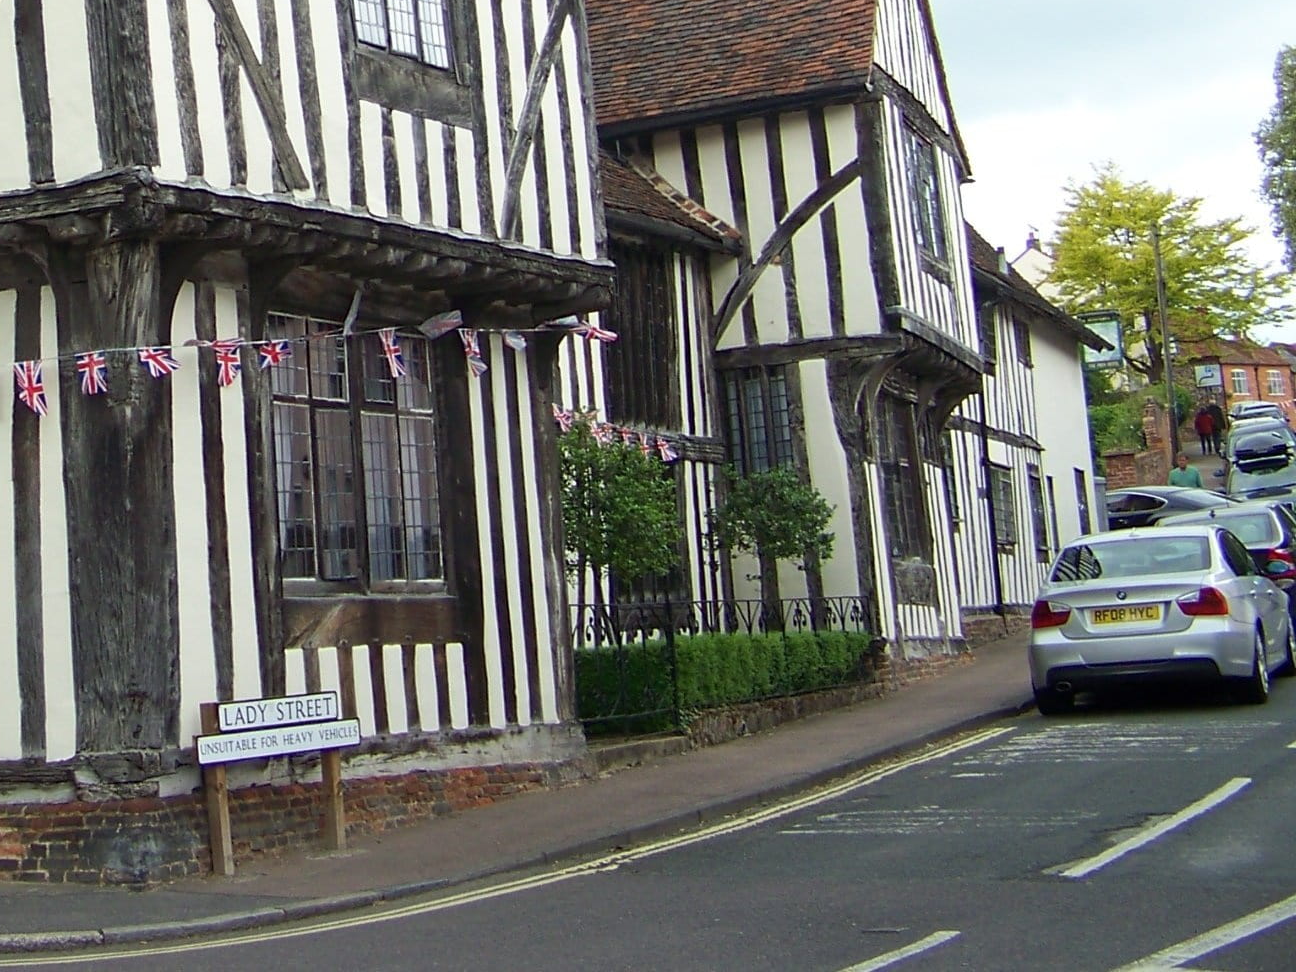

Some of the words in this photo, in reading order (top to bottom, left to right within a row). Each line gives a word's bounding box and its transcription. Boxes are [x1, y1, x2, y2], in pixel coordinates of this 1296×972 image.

[224, 704, 266, 726] LADY
[276, 697, 332, 721] STREET
[200, 738, 257, 756] UNSUITABLE
[260, 734, 279, 749] FOR
[283, 730, 314, 746] HEAVY
[319, 725, 358, 741] VEHICLES
